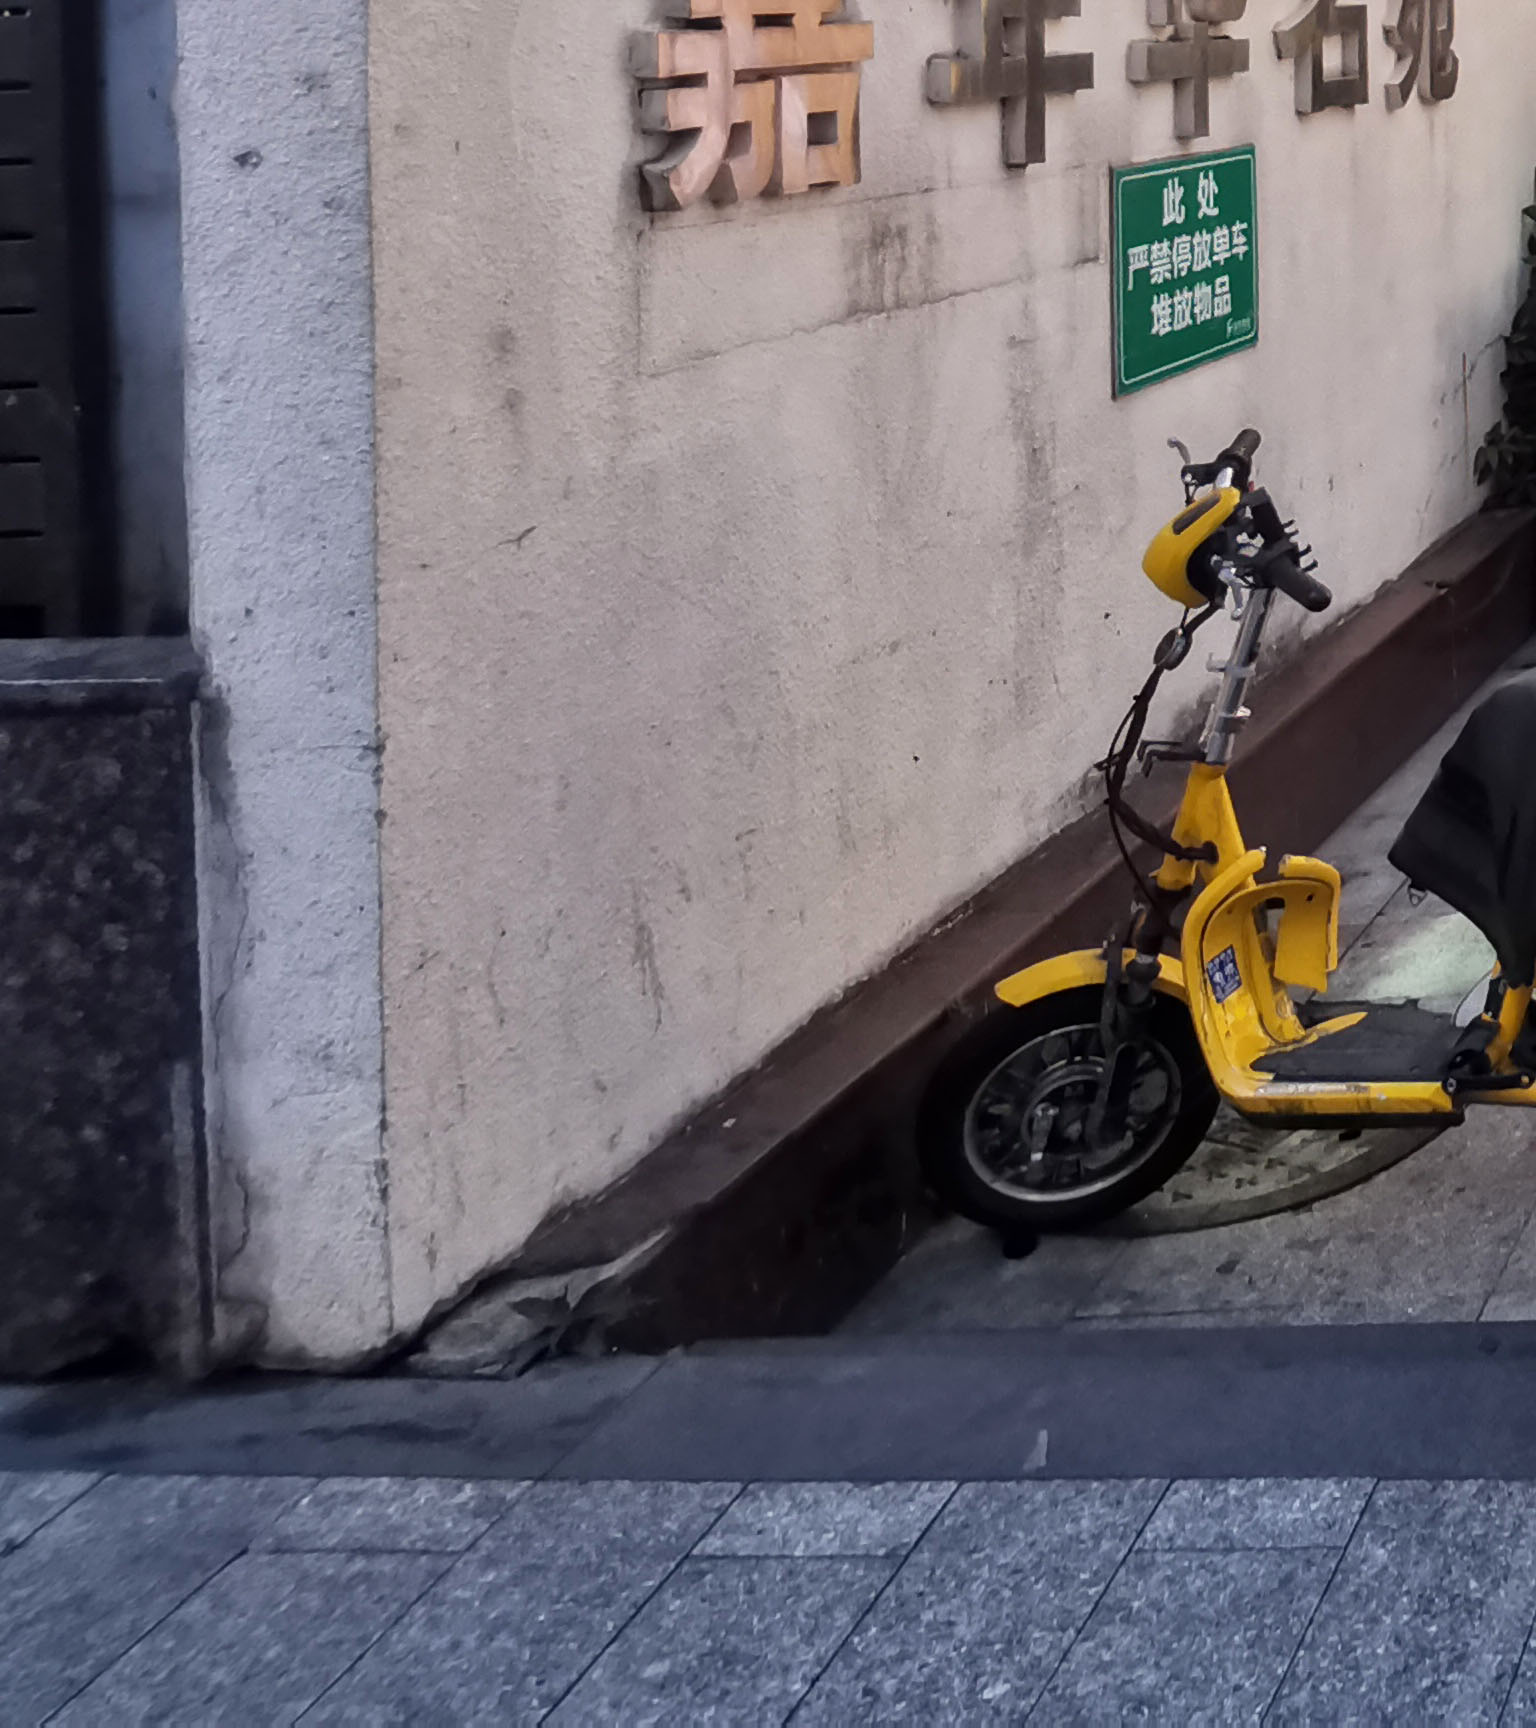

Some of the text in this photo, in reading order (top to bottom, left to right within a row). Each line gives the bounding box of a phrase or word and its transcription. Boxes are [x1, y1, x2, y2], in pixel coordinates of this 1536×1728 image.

[1162, 169, 1220, 227] 此处
[1127, 219, 1249, 291] 严禁停放单车
[1150, 274, 1232, 337] 堆放物品
